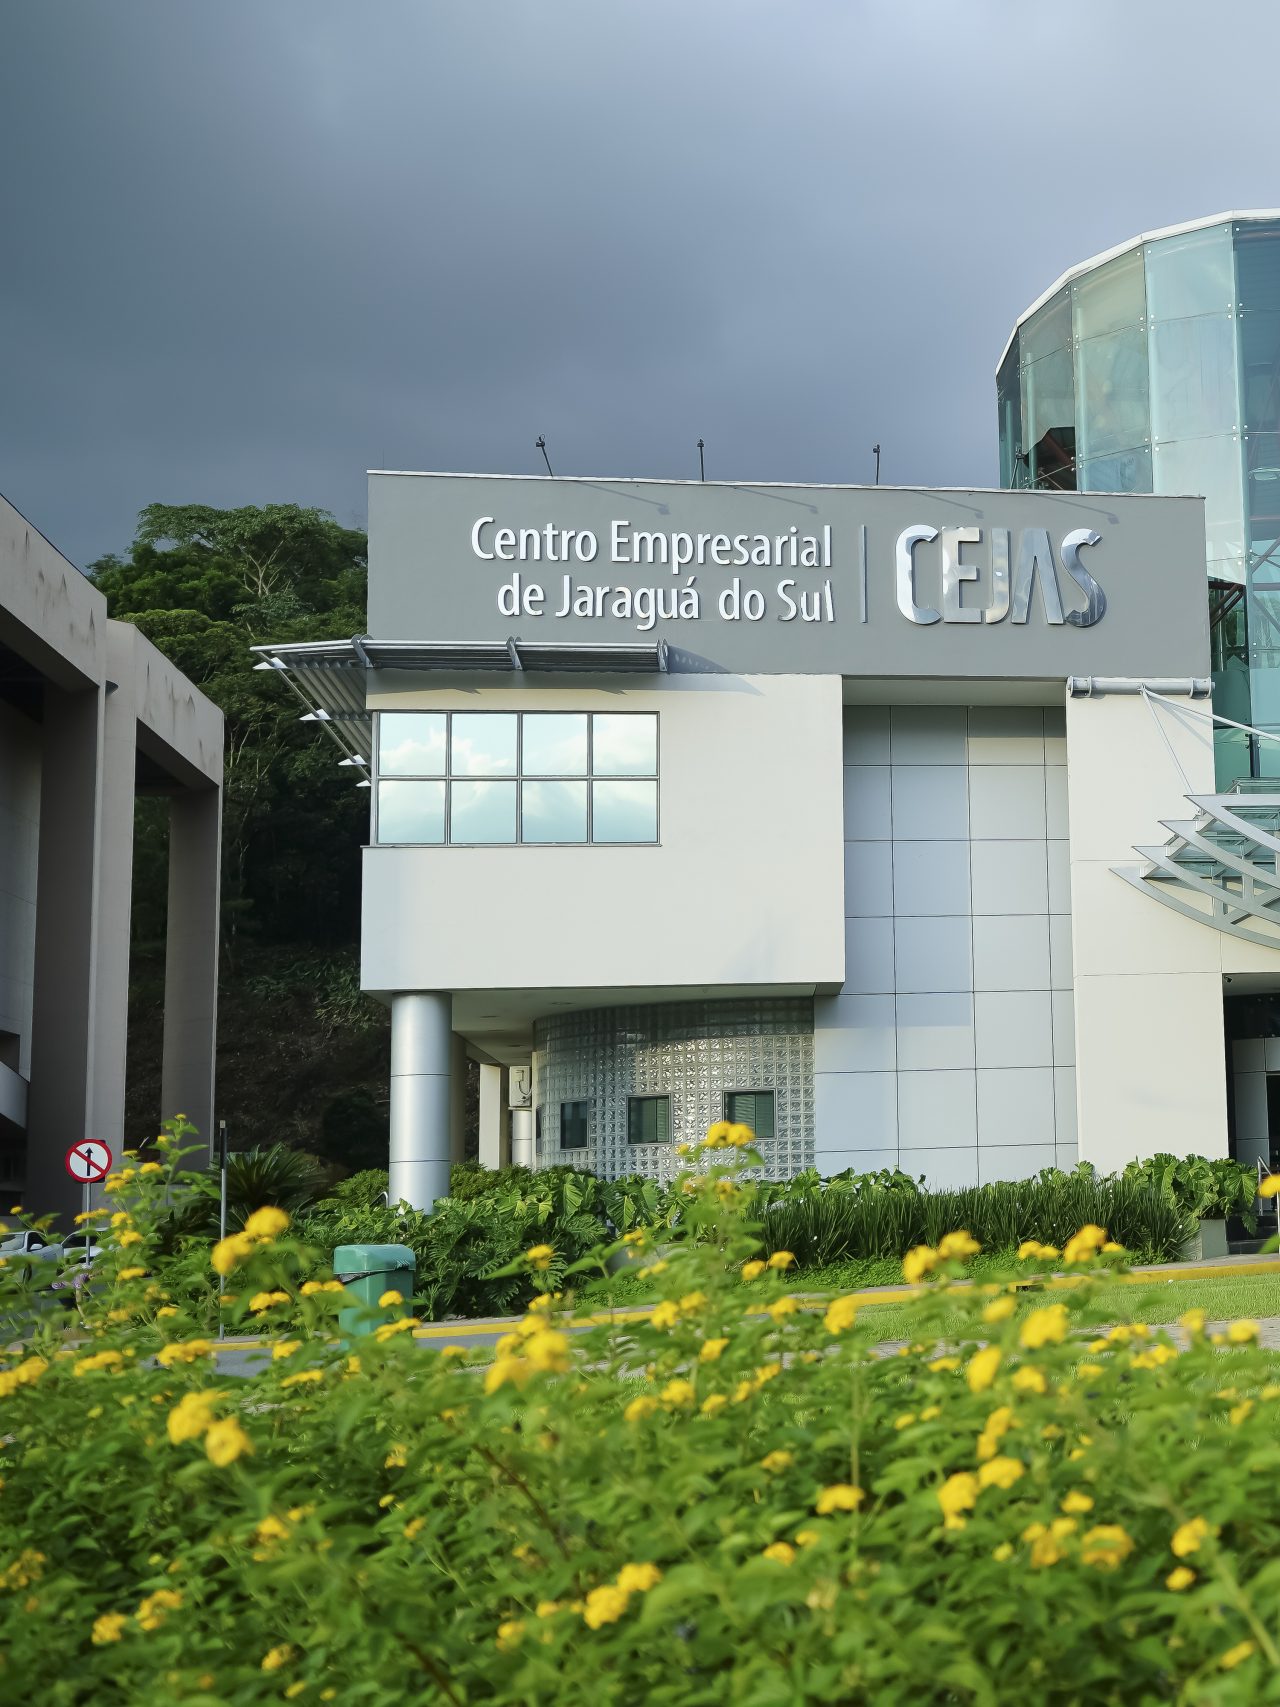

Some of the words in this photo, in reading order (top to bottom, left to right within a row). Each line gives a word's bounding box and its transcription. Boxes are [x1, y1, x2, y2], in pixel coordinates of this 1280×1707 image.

[471, 516, 599, 562] Centro
[611, 520, 832, 575] Empresarial
[497, 572, 545, 616] de
[555, 575, 700, 631] Jaraguá
[718, 577, 765, 621] do
[777, 579, 834, 622] Sul
[895, 524, 1107, 627] CEJAS
